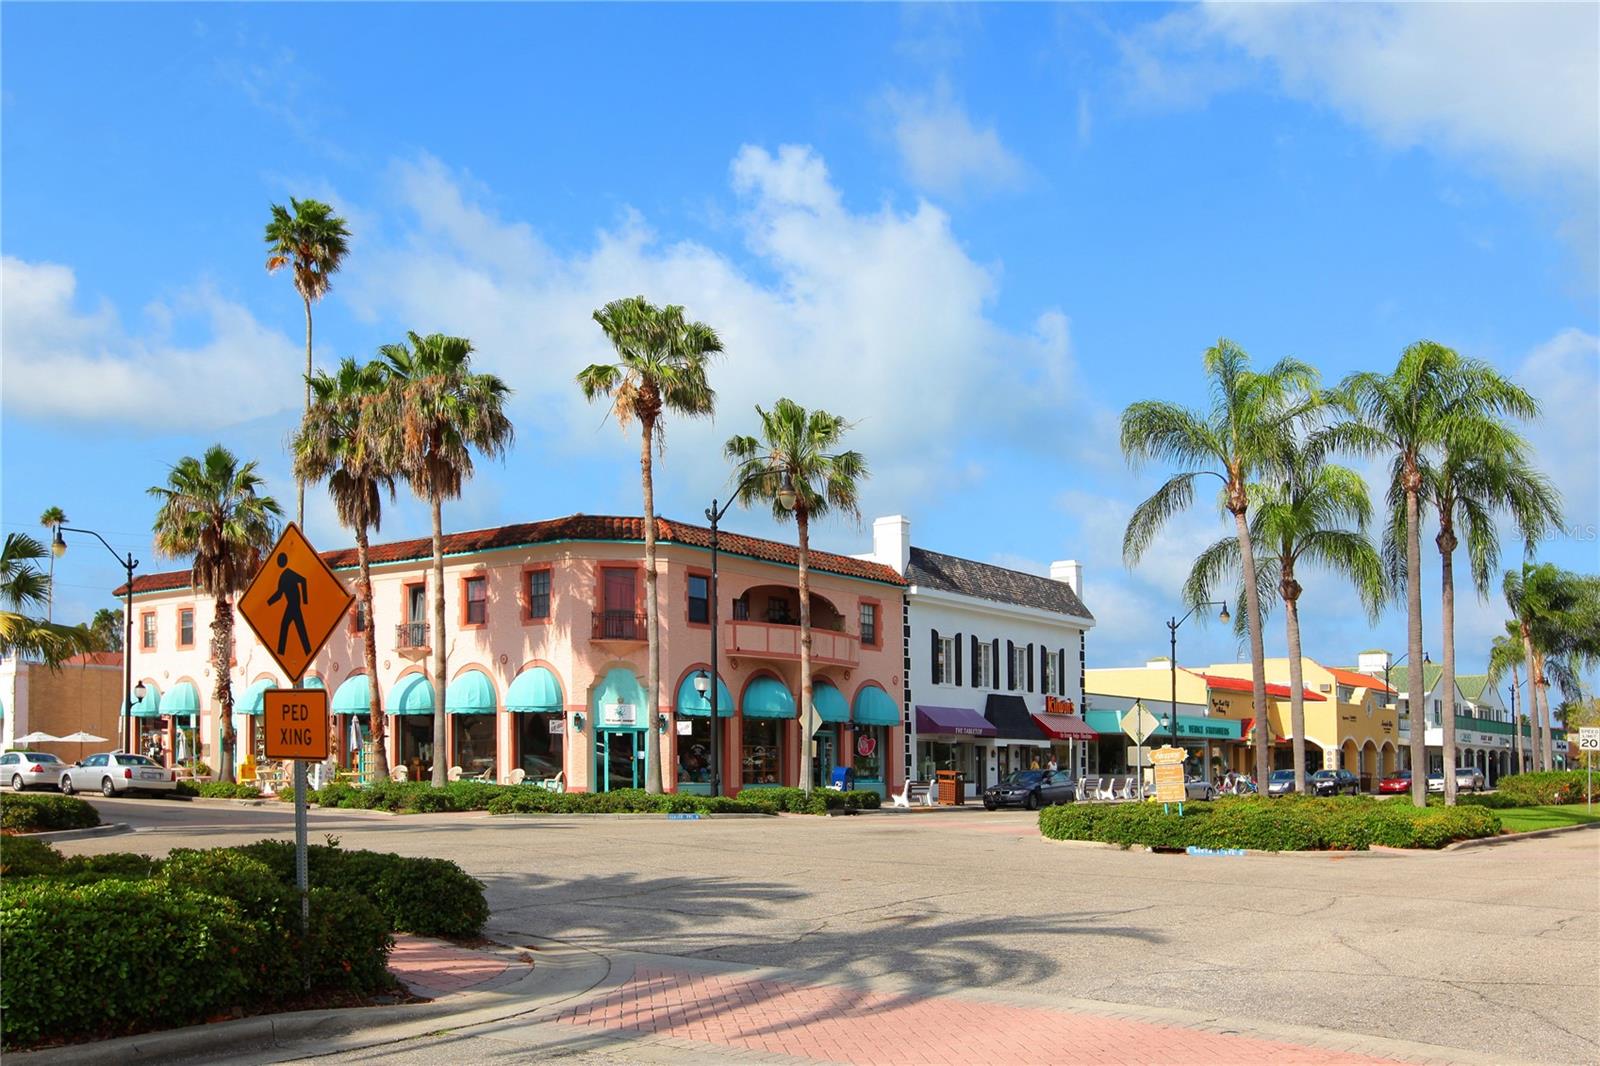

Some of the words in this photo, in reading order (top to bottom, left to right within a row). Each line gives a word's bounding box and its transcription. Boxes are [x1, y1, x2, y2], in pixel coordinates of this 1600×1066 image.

[282, 704, 309, 721] PED
[280, 727, 312, 746] XING
[1581, 738, 1598, 748] 20
